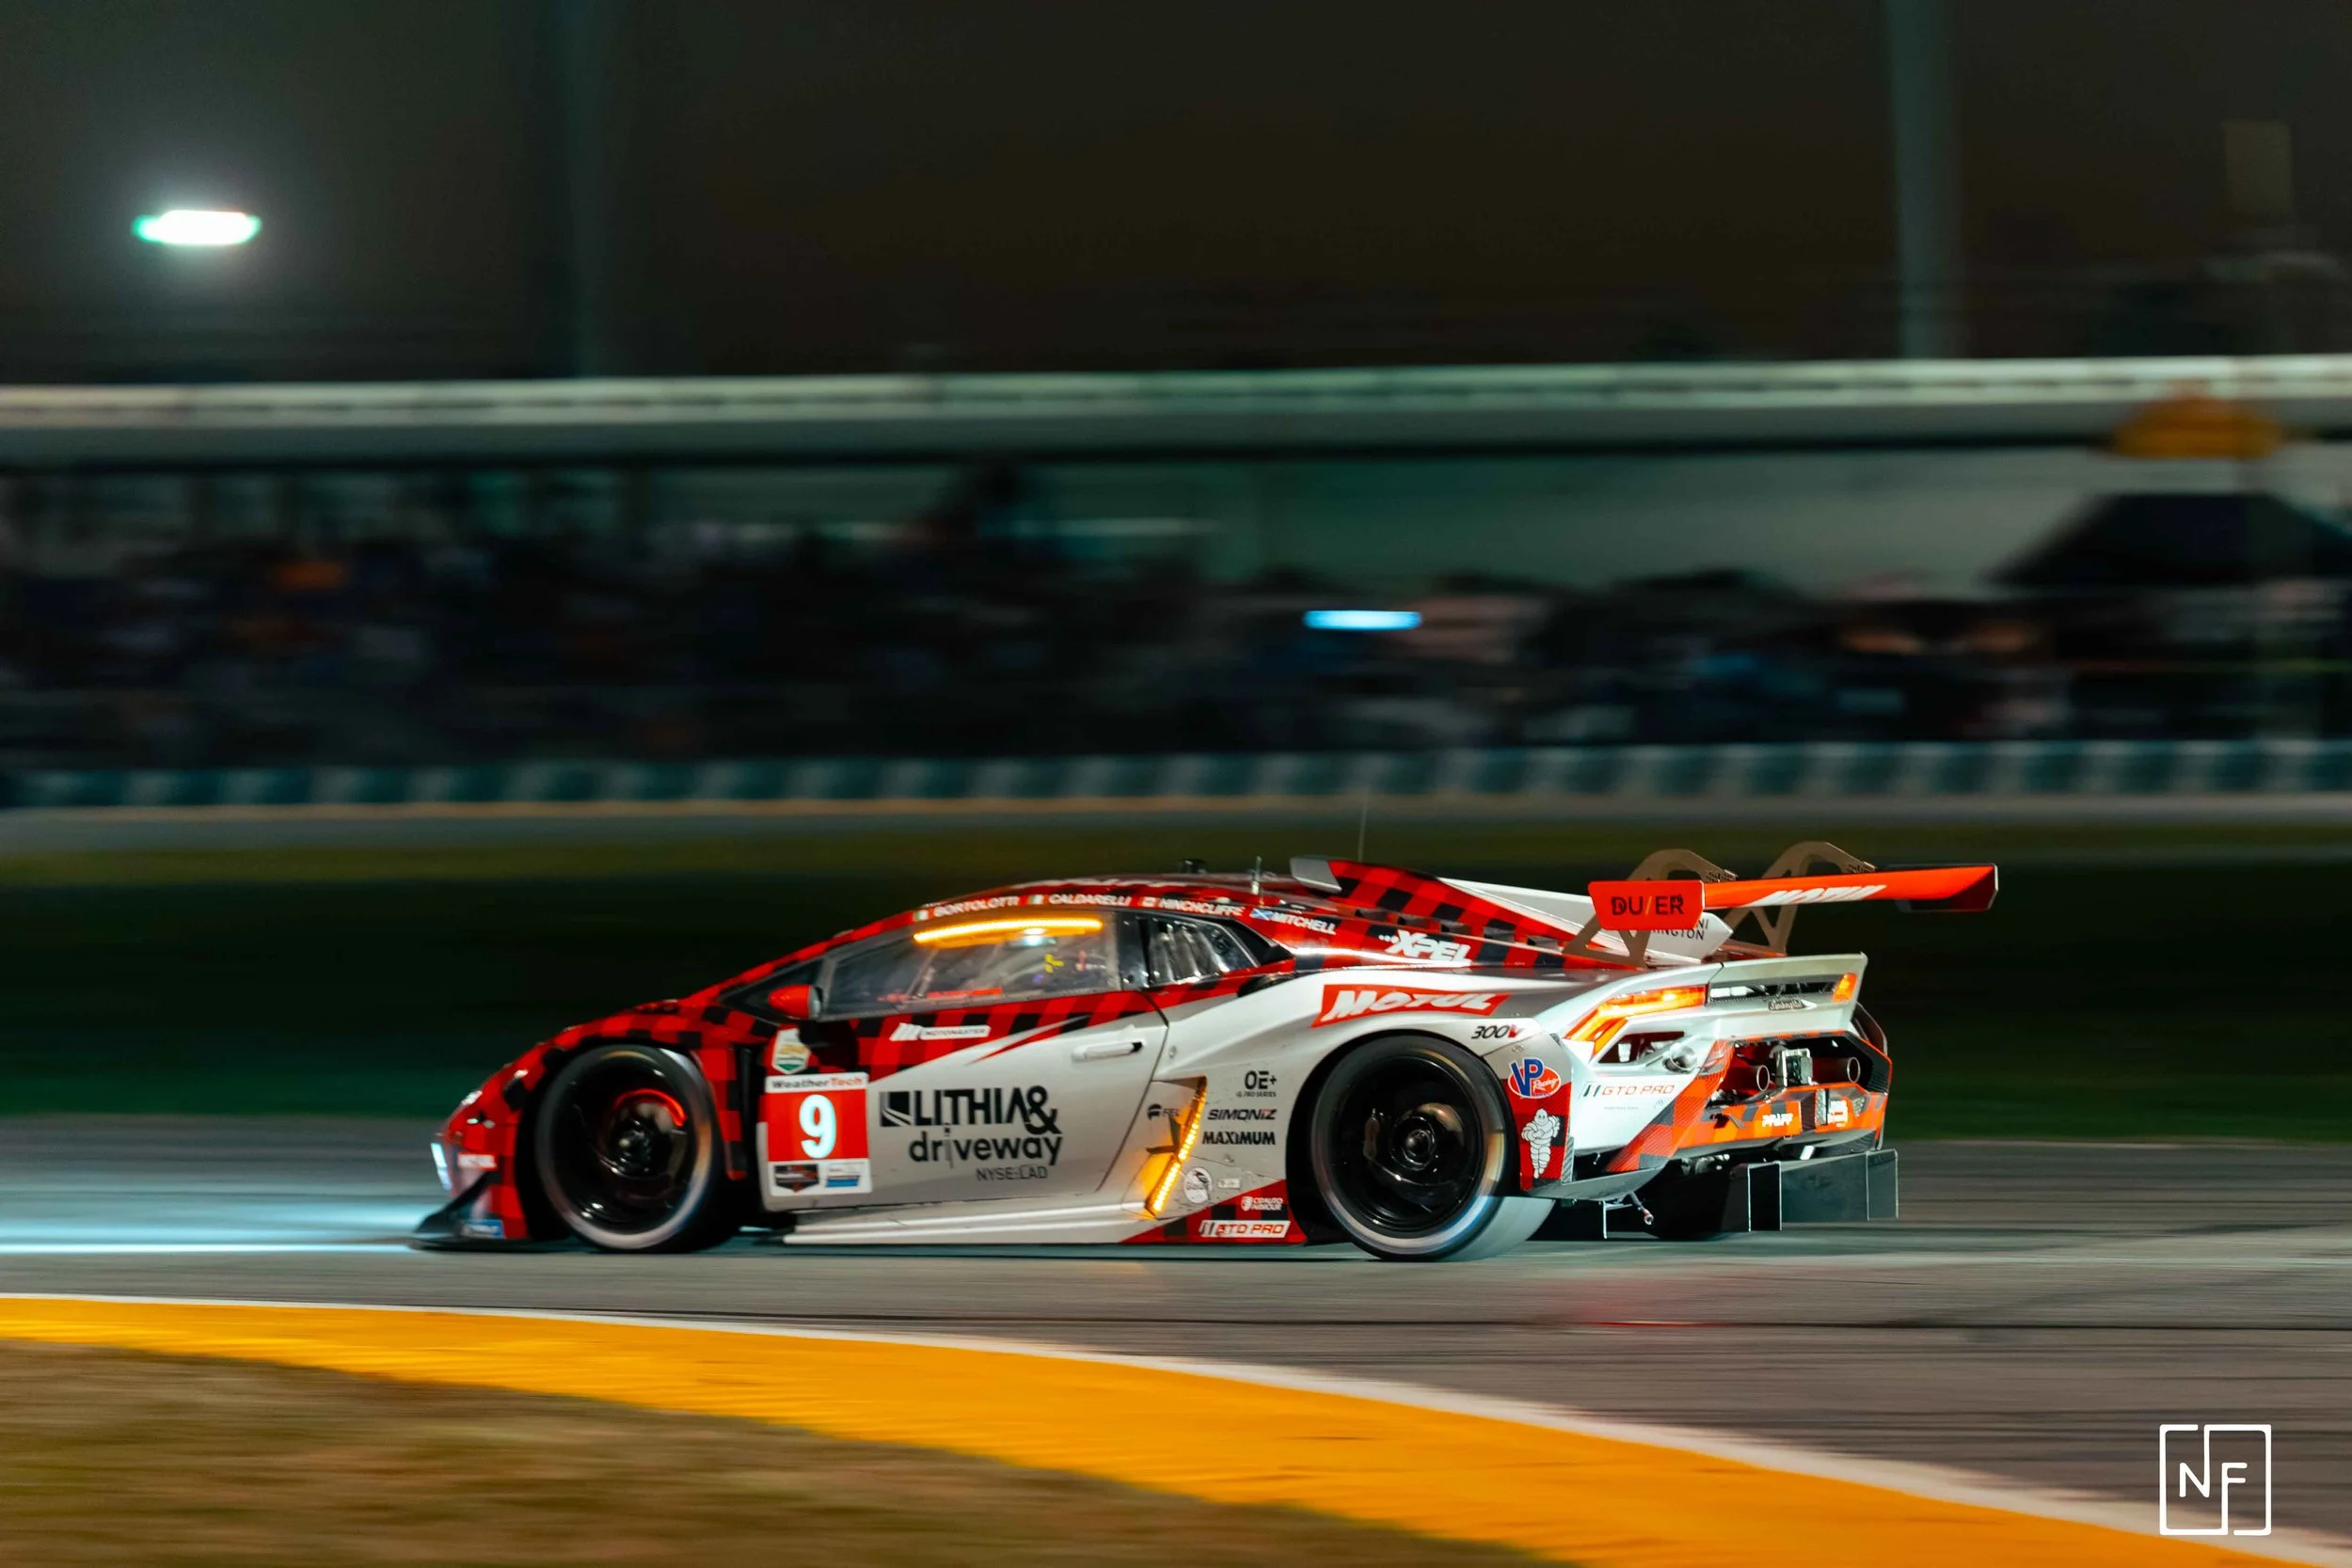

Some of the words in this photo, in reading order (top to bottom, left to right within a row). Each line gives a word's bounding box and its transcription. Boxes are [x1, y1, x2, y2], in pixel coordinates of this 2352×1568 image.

[933, 895, 1020, 917] BORTOLOTTI
[1049, 894, 1132, 907] CALDARELLI
[1271, 911, 1337, 935] MITCHELL
[1321, 990, 1497, 1022] MOTUL
[1470, 1025, 1525, 1039] 300V
[771, 1077, 864, 1089] WeatherTech
[1245, 1070, 1278, 1089] OE+
[1509, 1057, 1544, 1098] VP
[1641, 1085, 1675, 1095] PRO
[1207, 1108, 1278, 1121] SIMONIZ
[799, 1094, 837, 1159] 9
[909, 1127, 1063, 1167] driveway
[1201, 1131, 1276, 1146] MAXIMUM
[1249, 1223, 1285, 1235] PRO
